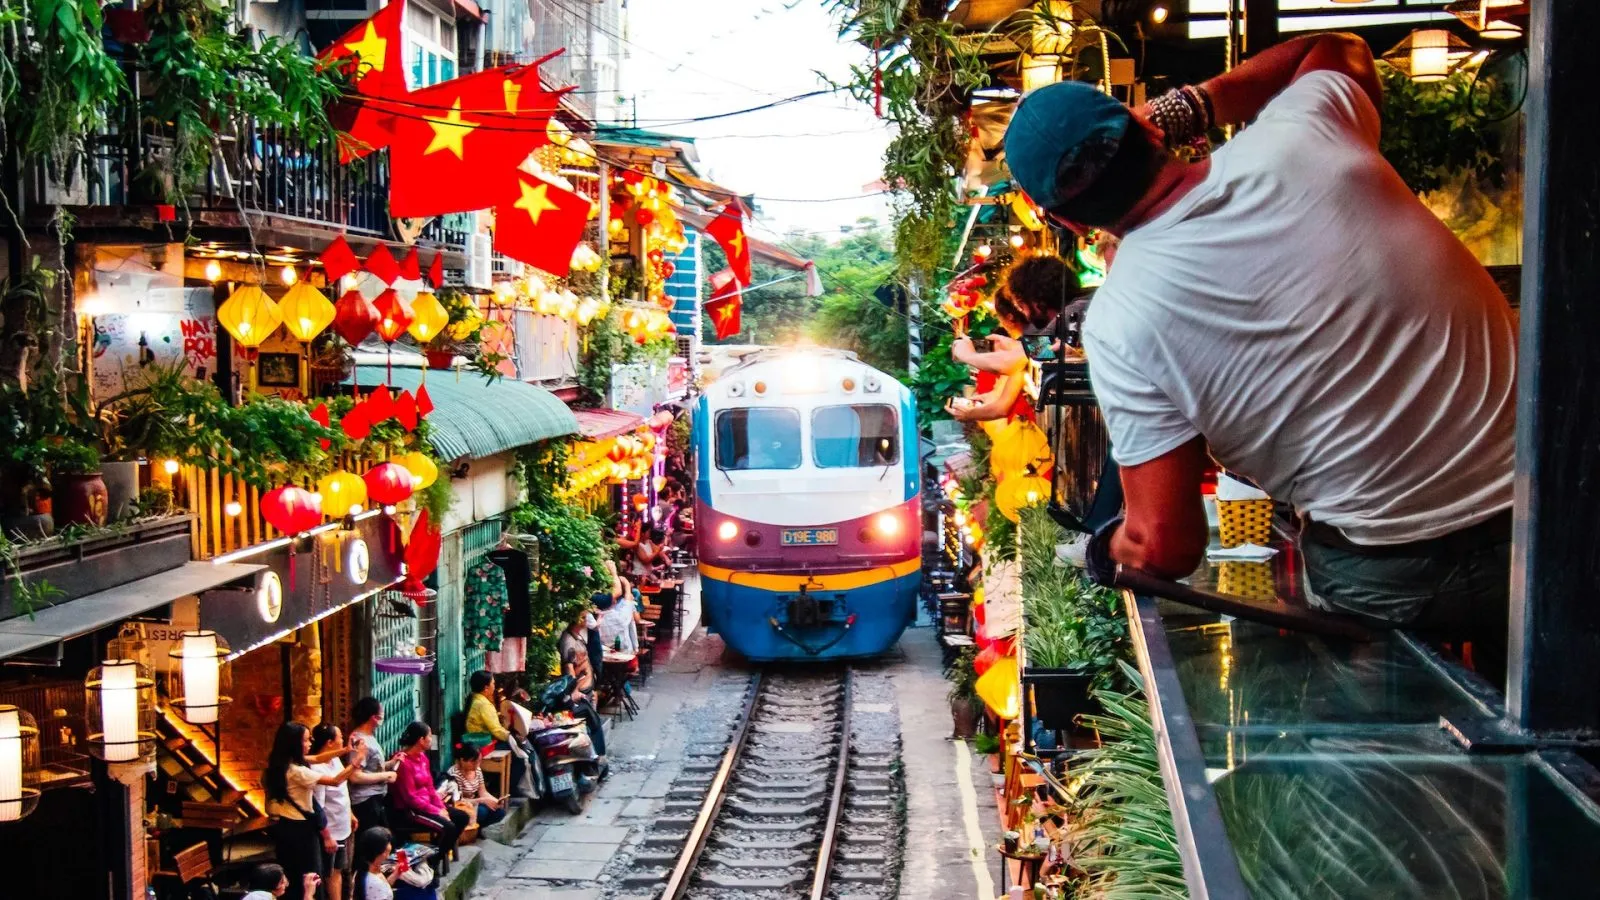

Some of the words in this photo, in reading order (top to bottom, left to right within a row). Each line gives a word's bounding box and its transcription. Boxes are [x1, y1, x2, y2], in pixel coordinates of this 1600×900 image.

[184, 338, 258, 360] POLND
[784, 530, 836, 543] D19E-980
[144, 629, 185, 641] OREST
